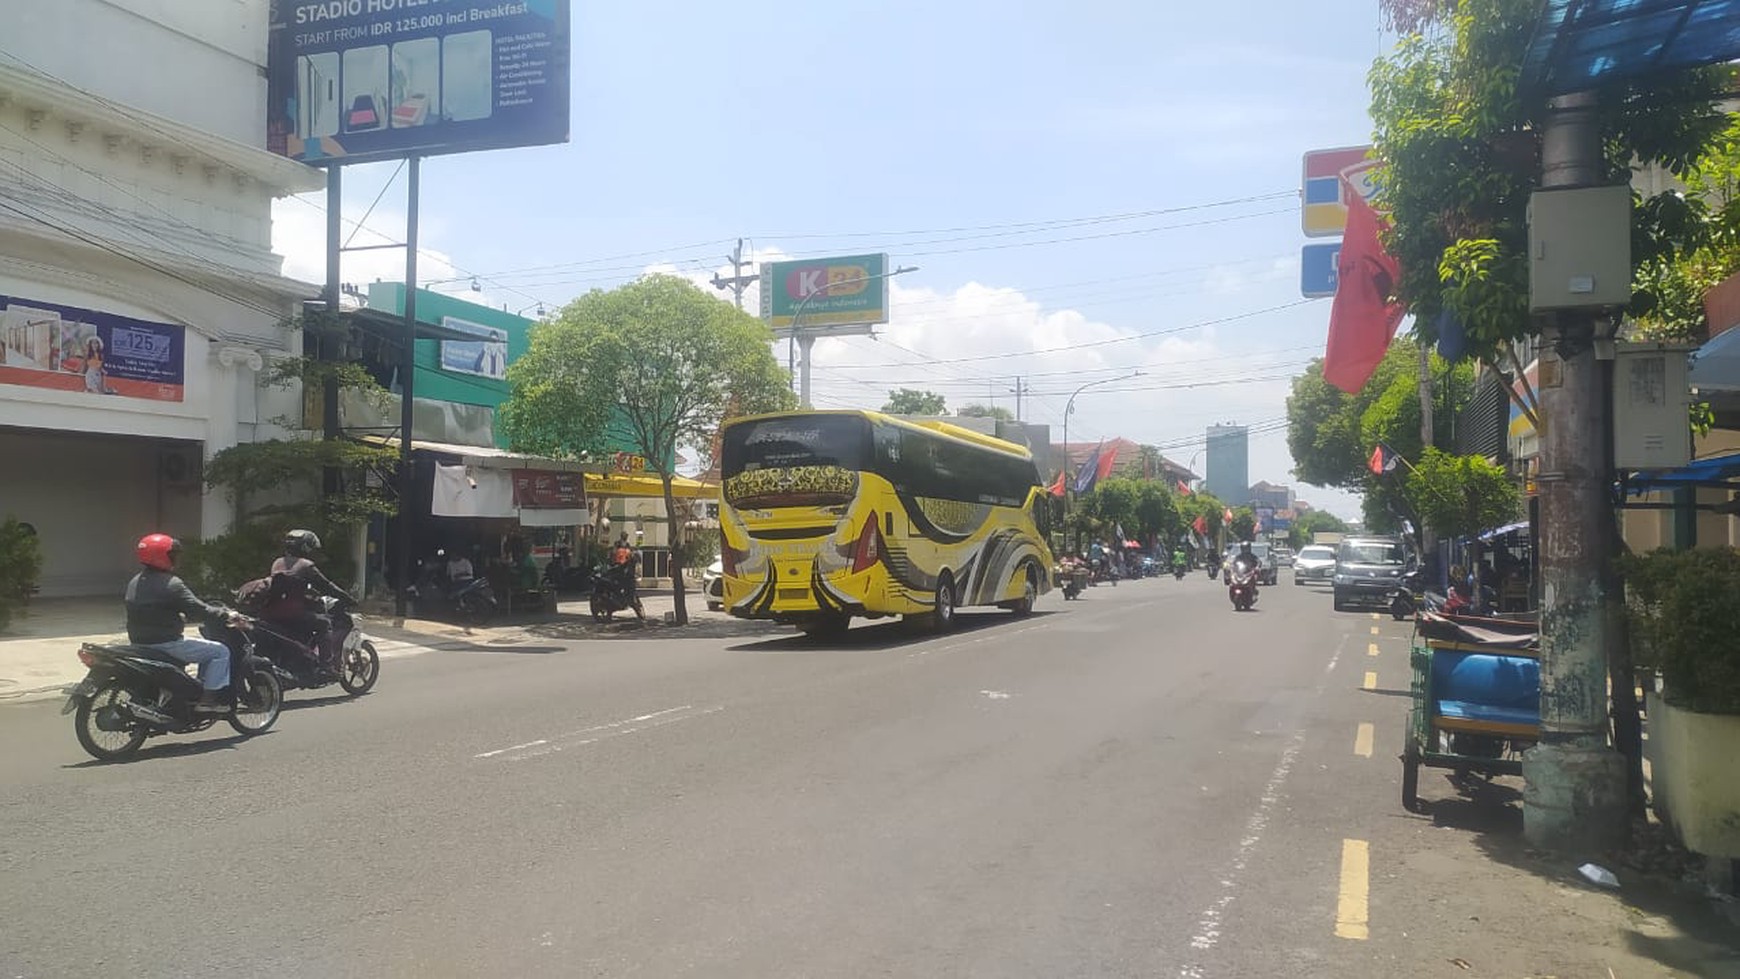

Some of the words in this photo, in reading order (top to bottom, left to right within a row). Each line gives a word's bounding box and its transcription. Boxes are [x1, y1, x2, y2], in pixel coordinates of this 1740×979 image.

[295, 30, 332, 46] START
[334, 25, 367, 41] FROM
[371, 21, 397, 36] IDR
[396, 14, 443, 32] 125.000
[470, 3, 528, 21] Breakfast
[296, 0, 361, 24] STADIO
[368, 0, 428, 12] HOT
